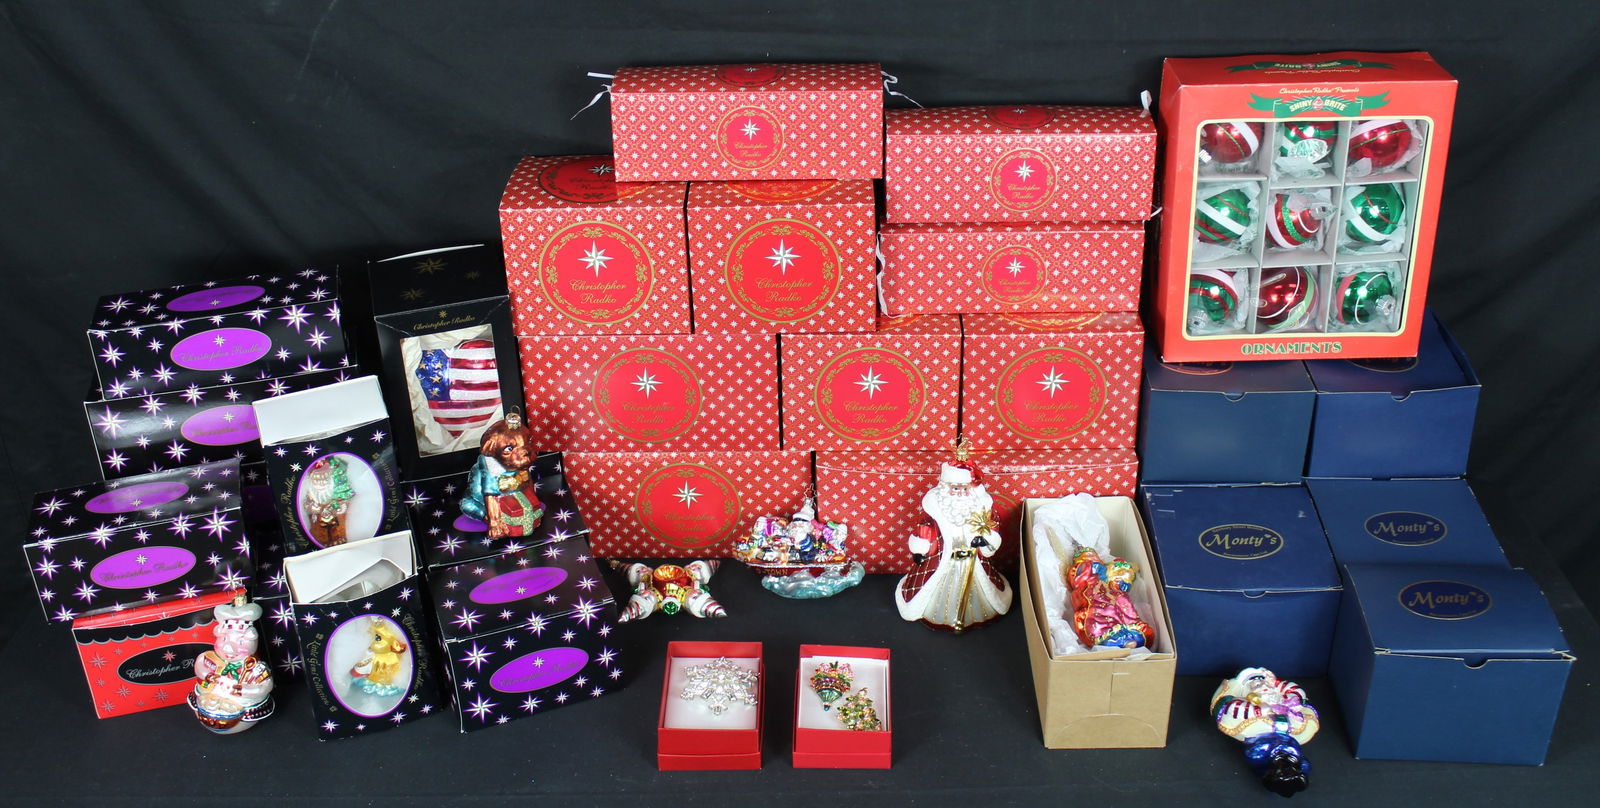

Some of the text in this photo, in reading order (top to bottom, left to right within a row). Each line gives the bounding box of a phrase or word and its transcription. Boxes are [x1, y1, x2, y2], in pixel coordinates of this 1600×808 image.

[1289, 99, 1348, 112] SHINY BRITE
[569, 279, 627, 293] Christopher
[756, 277, 813, 290] Christopher
[580, 293, 617, 304] Radko
[765, 291, 802, 303] Radko
[413, 319, 451, 330] Christopher
[1241, 341, 1342, 355] ORNAMENTS
[843, 400, 898, 413] Christopher
[1024, 400, 1079, 413] Christopher
[851, 413, 887, 424] Radko
[1032, 413, 1068, 424] Radko
[126, 662, 180, 679] Christopher
